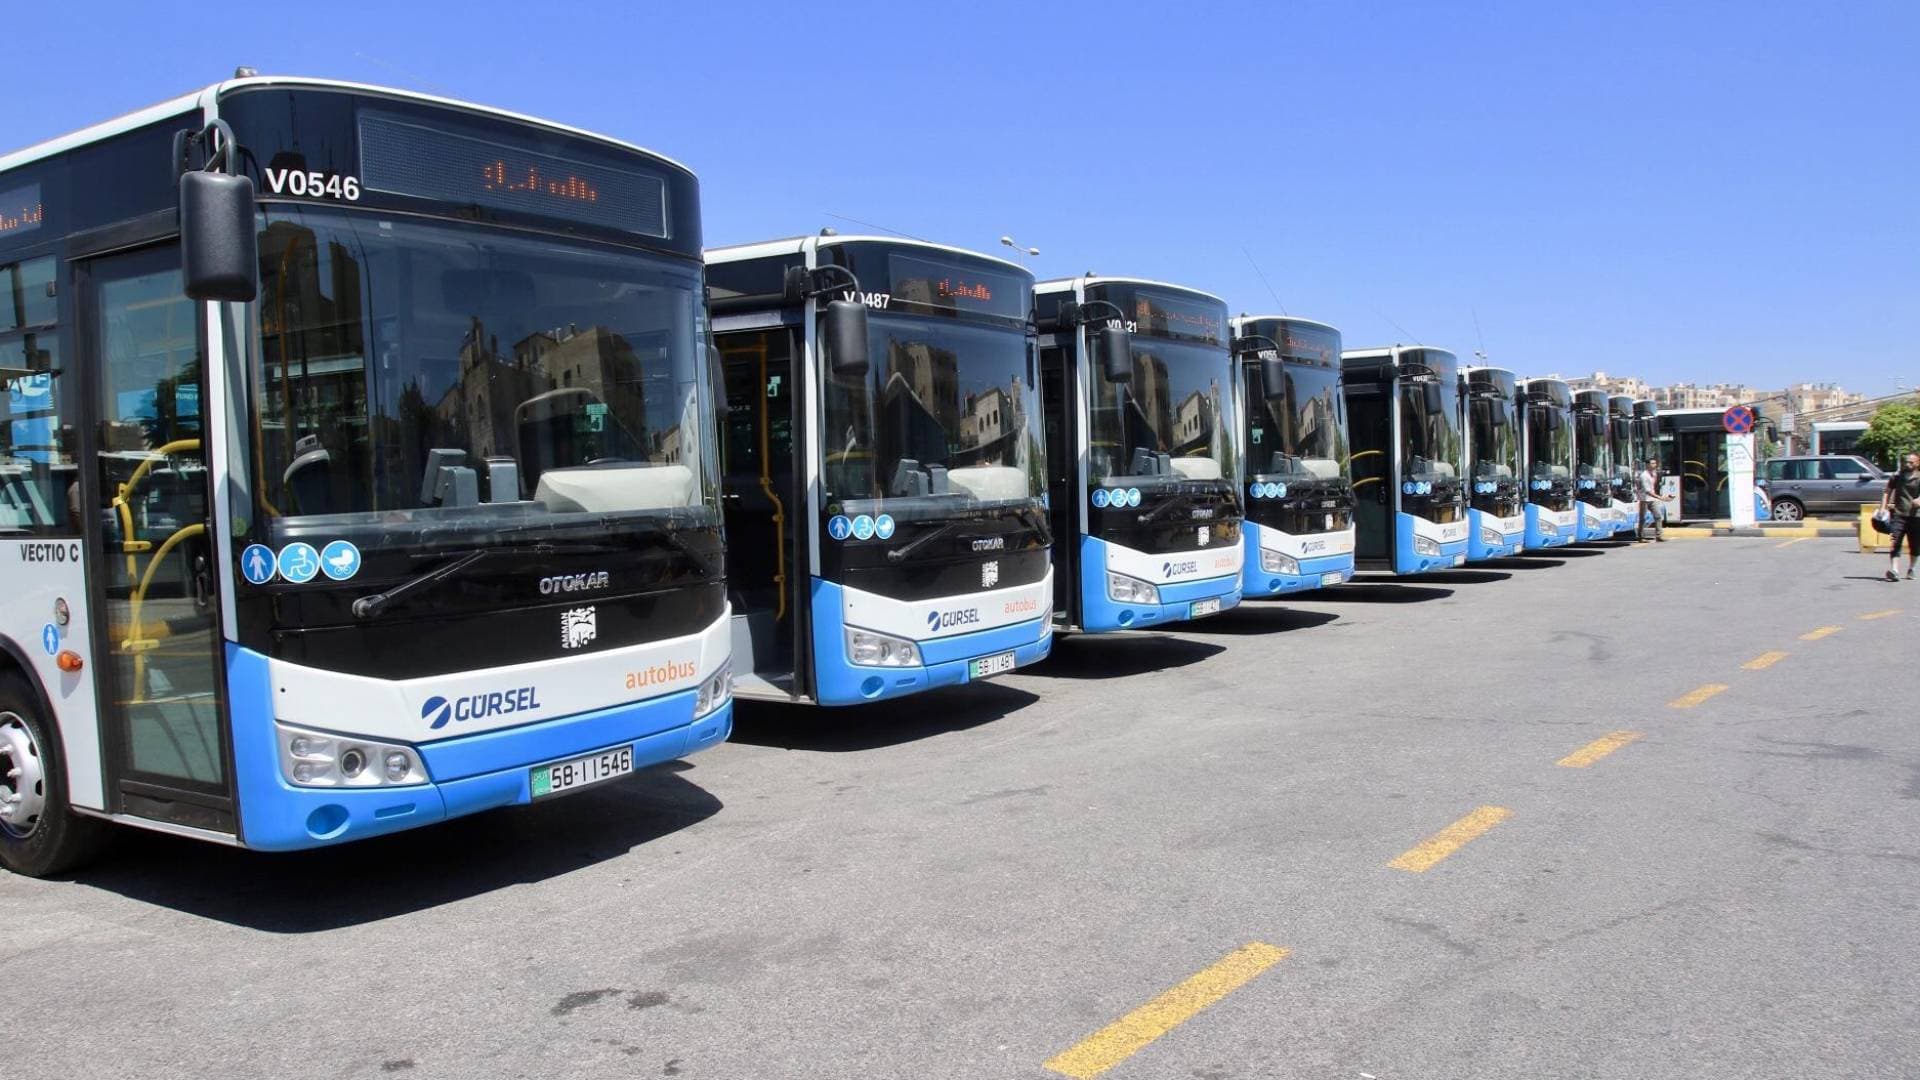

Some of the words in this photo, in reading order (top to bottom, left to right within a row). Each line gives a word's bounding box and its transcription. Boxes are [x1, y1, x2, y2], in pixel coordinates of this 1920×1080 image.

[264, 167, 360, 200] V0546
[1106, 319, 1137, 334] V021
[20, 543, 66, 562] VECTIO
[70, 543, 79, 562] C
[971, 537, 1004, 551] OTOKAR
[539, 571, 609, 595] OTOKAR
[1003, 598, 1037, 615] autobus
[560, 612, 569, 649] AMMAN
[625, 659, 696, 689] autobus
[455, 686, 540, 722] GÜRSEL
